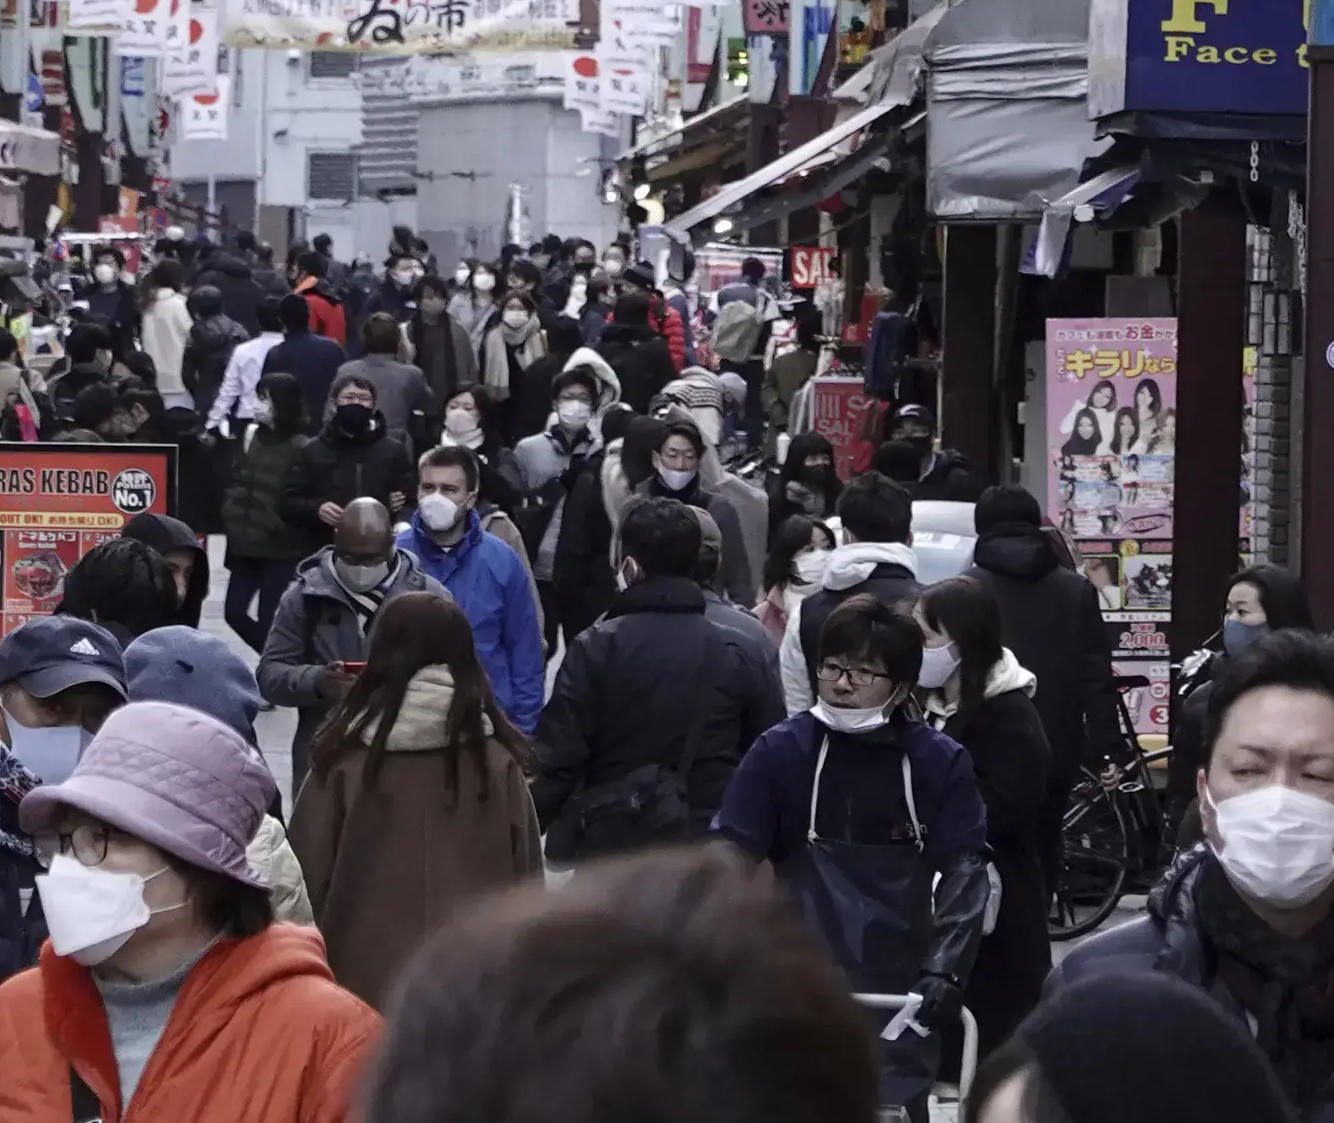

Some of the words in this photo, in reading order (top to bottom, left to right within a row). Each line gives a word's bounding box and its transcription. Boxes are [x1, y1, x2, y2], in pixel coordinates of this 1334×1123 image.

[1164, 36, 1278, 65] Face
[794, 252, 836, 286] SAL
[1066, 346, 1177, 379] キラリなら
[40, 469, 110, 496] KEBAB
[115, 491, 152, 508] No.1
[0, 513, 22, 525] OUT
[24, 513, 44, 525] OK!
[97, 516, 119, 526] OK!
